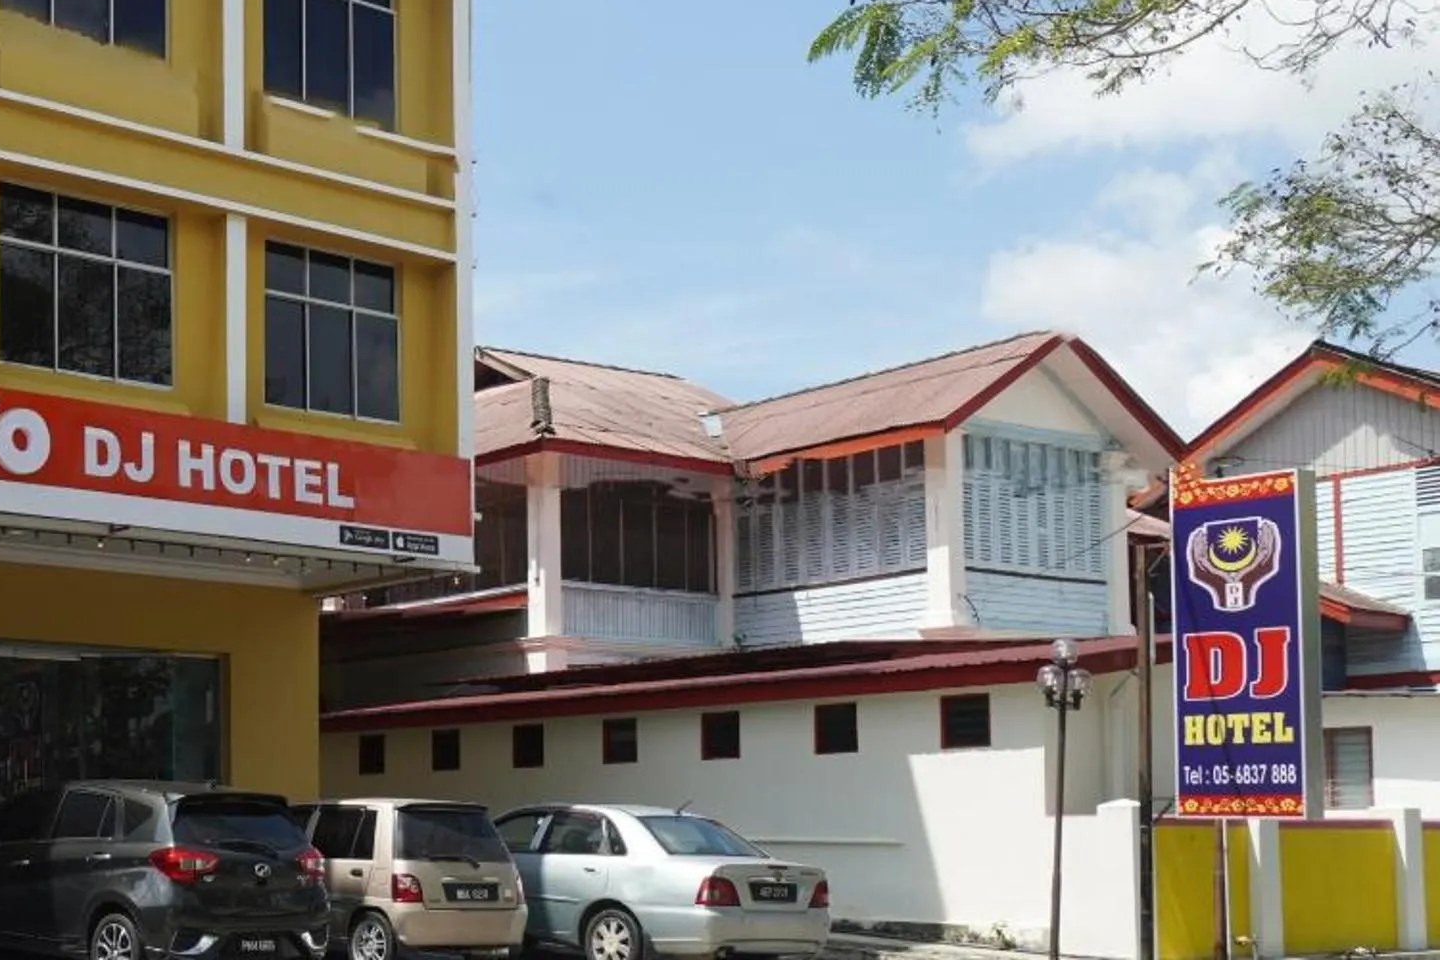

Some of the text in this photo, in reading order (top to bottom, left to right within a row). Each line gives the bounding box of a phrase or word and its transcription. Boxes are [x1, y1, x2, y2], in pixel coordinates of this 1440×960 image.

[83, 425, 155, 484] DJ
[178, 439, 355, 509] HOTEL
[1183, 626, 1291, 701] DJ
[1184, 712, 1294, 746] HOTEL
[1212, 764, 1268, 785] 05-6837
[1271, 763, 1297, 785] 888
